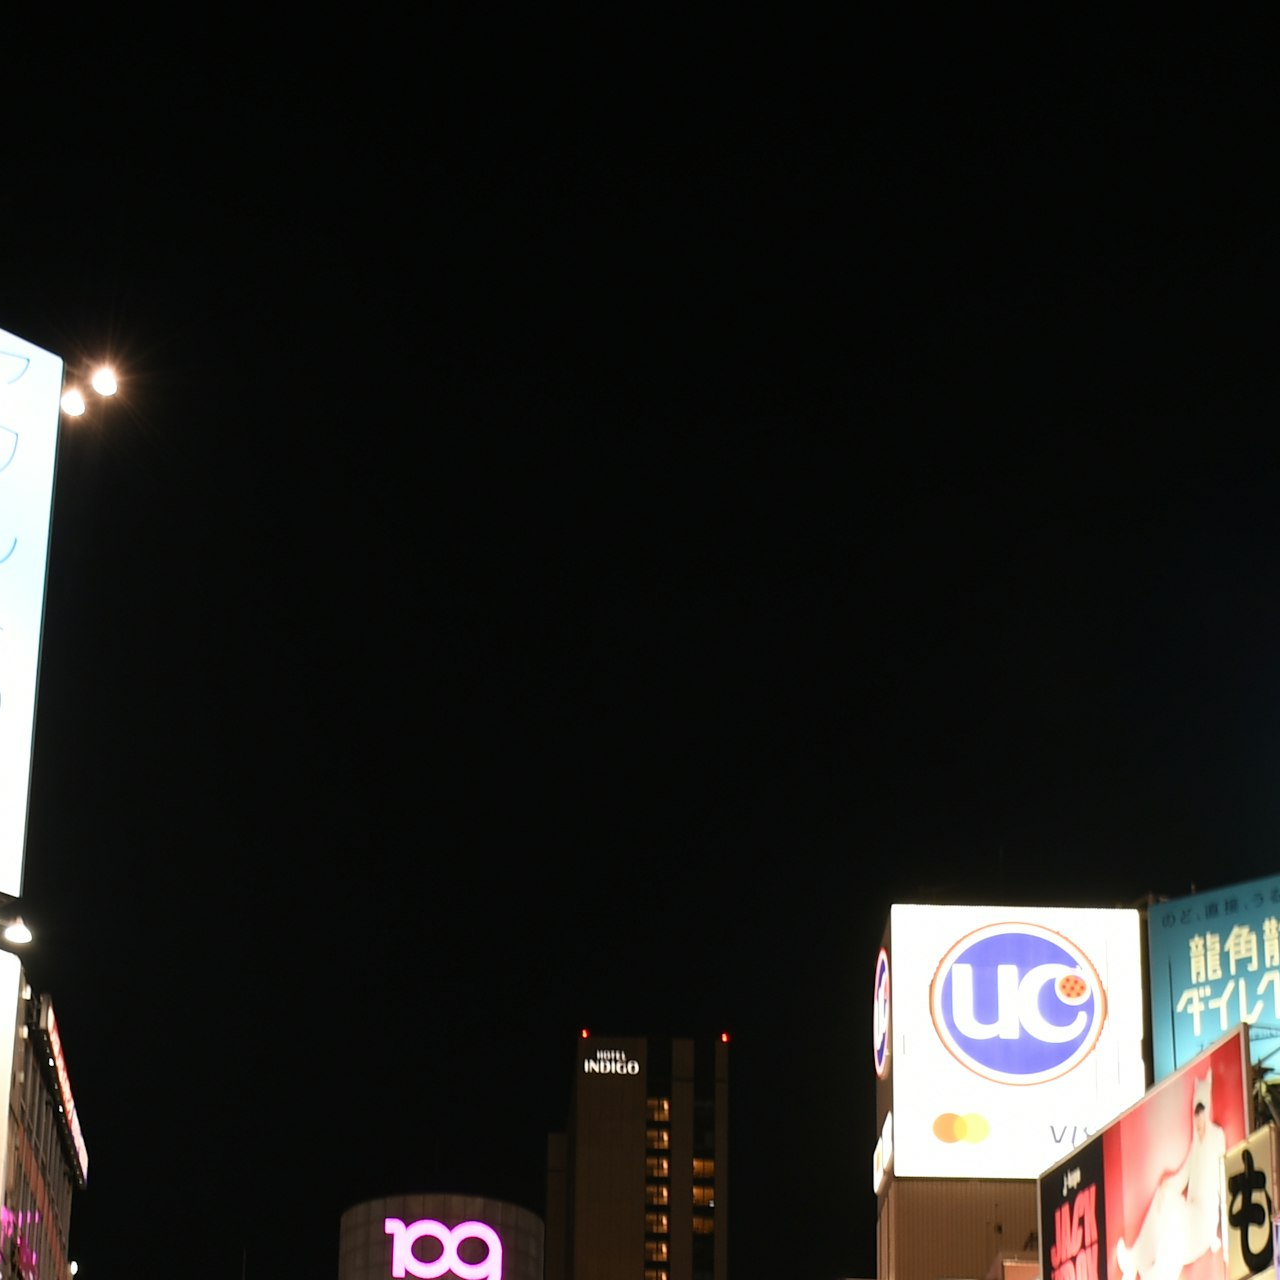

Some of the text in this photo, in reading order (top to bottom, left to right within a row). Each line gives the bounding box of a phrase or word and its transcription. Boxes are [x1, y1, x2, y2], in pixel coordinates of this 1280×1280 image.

[596, 1049, 626, 1061] HOTEL
[584, 1059, 640, 1075] INDIGO
[1051, 1183, 1098, 1268] JACK
